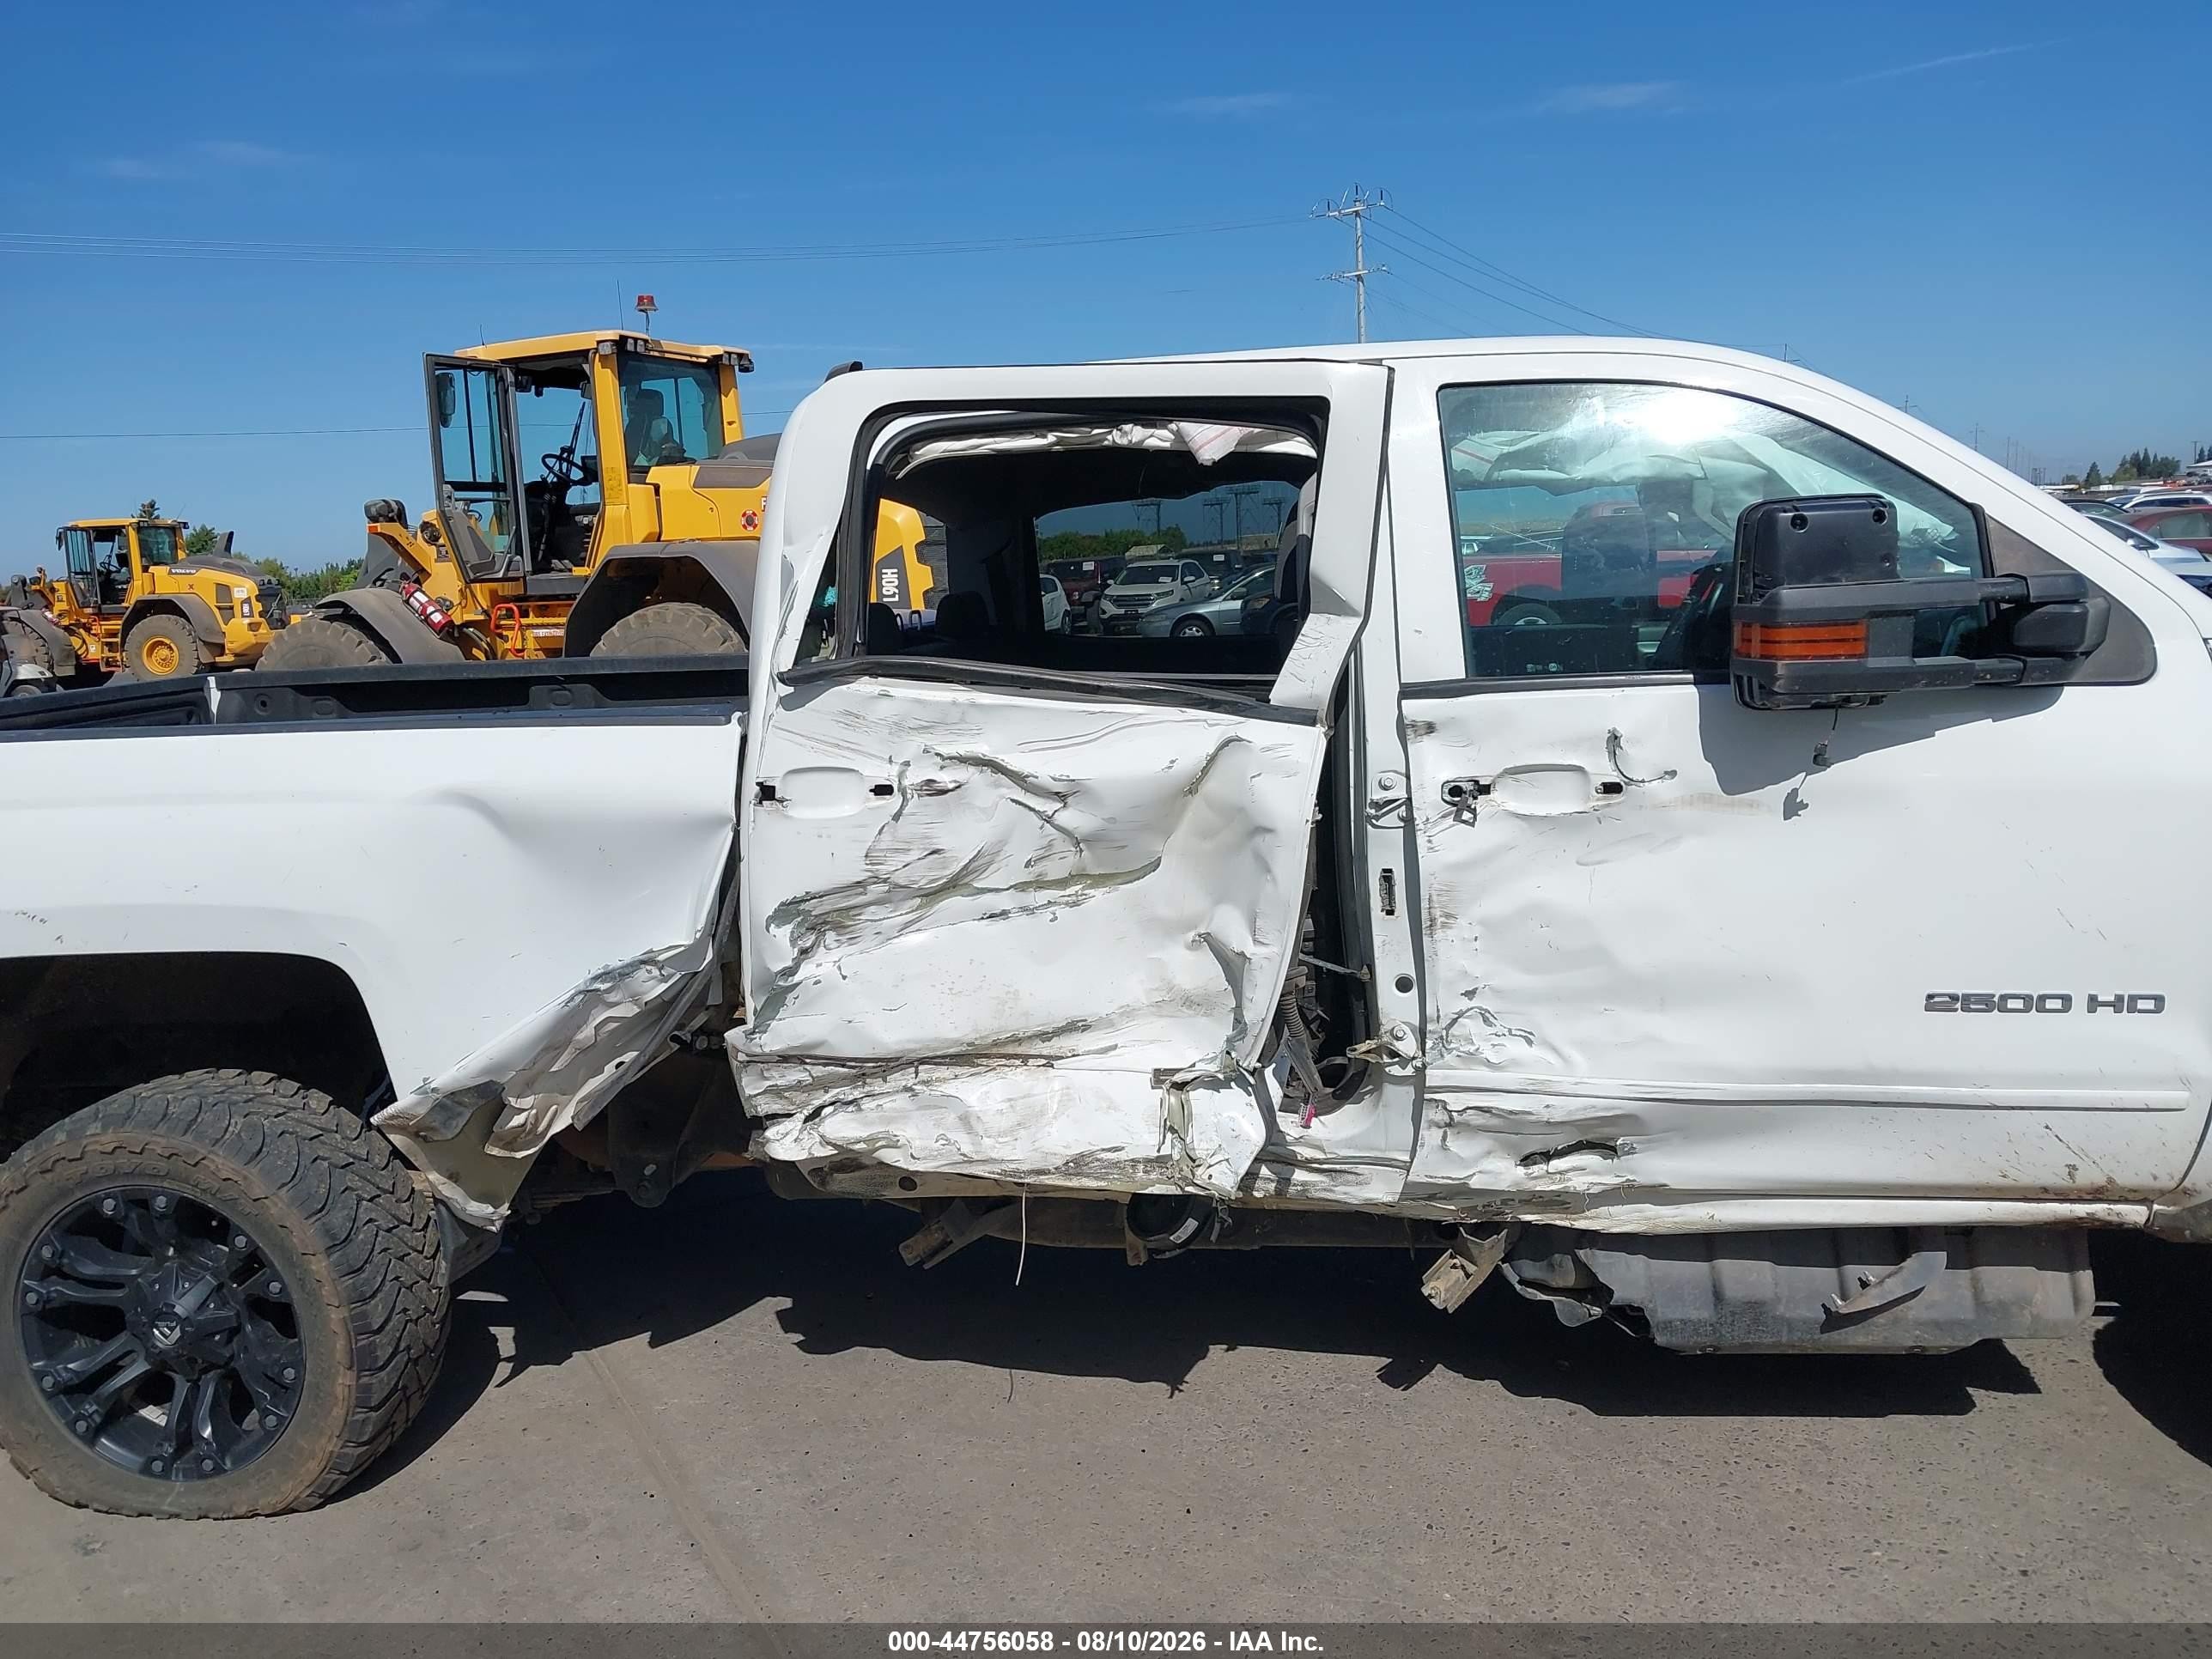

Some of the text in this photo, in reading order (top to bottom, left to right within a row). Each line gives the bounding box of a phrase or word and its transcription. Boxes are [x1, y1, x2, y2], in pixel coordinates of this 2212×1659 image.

[881, 568, 899, 602] L90H
[1924, 993, 2166, 1014] 2500 HD
